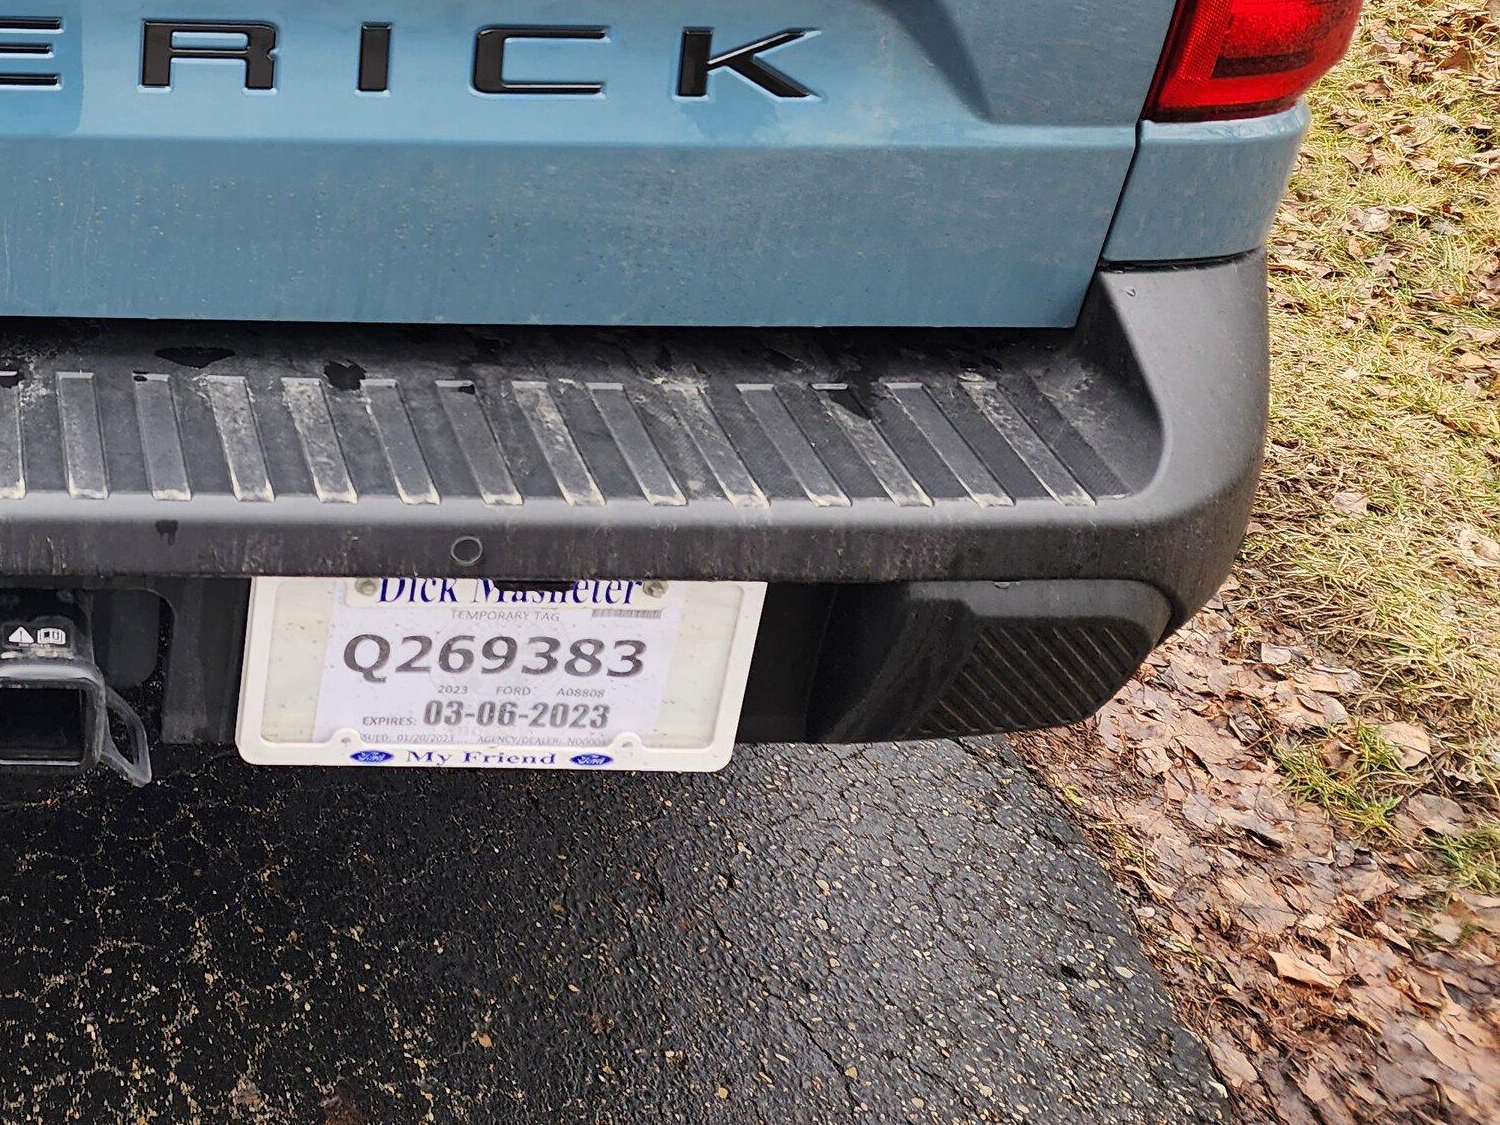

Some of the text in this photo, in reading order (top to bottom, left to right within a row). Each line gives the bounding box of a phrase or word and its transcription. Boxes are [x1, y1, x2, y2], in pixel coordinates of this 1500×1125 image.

[450, 608, 560, 622] TEMPORARY TAG
[343, 633, 647, 684] Q269383
[437, 684, 468, 695] 2023
[496, 685, 531, 696] FORD
[362, 700, 610, 729] EXPIRES: 03-06-2023
[406, 750, 557, 766] My Friend
